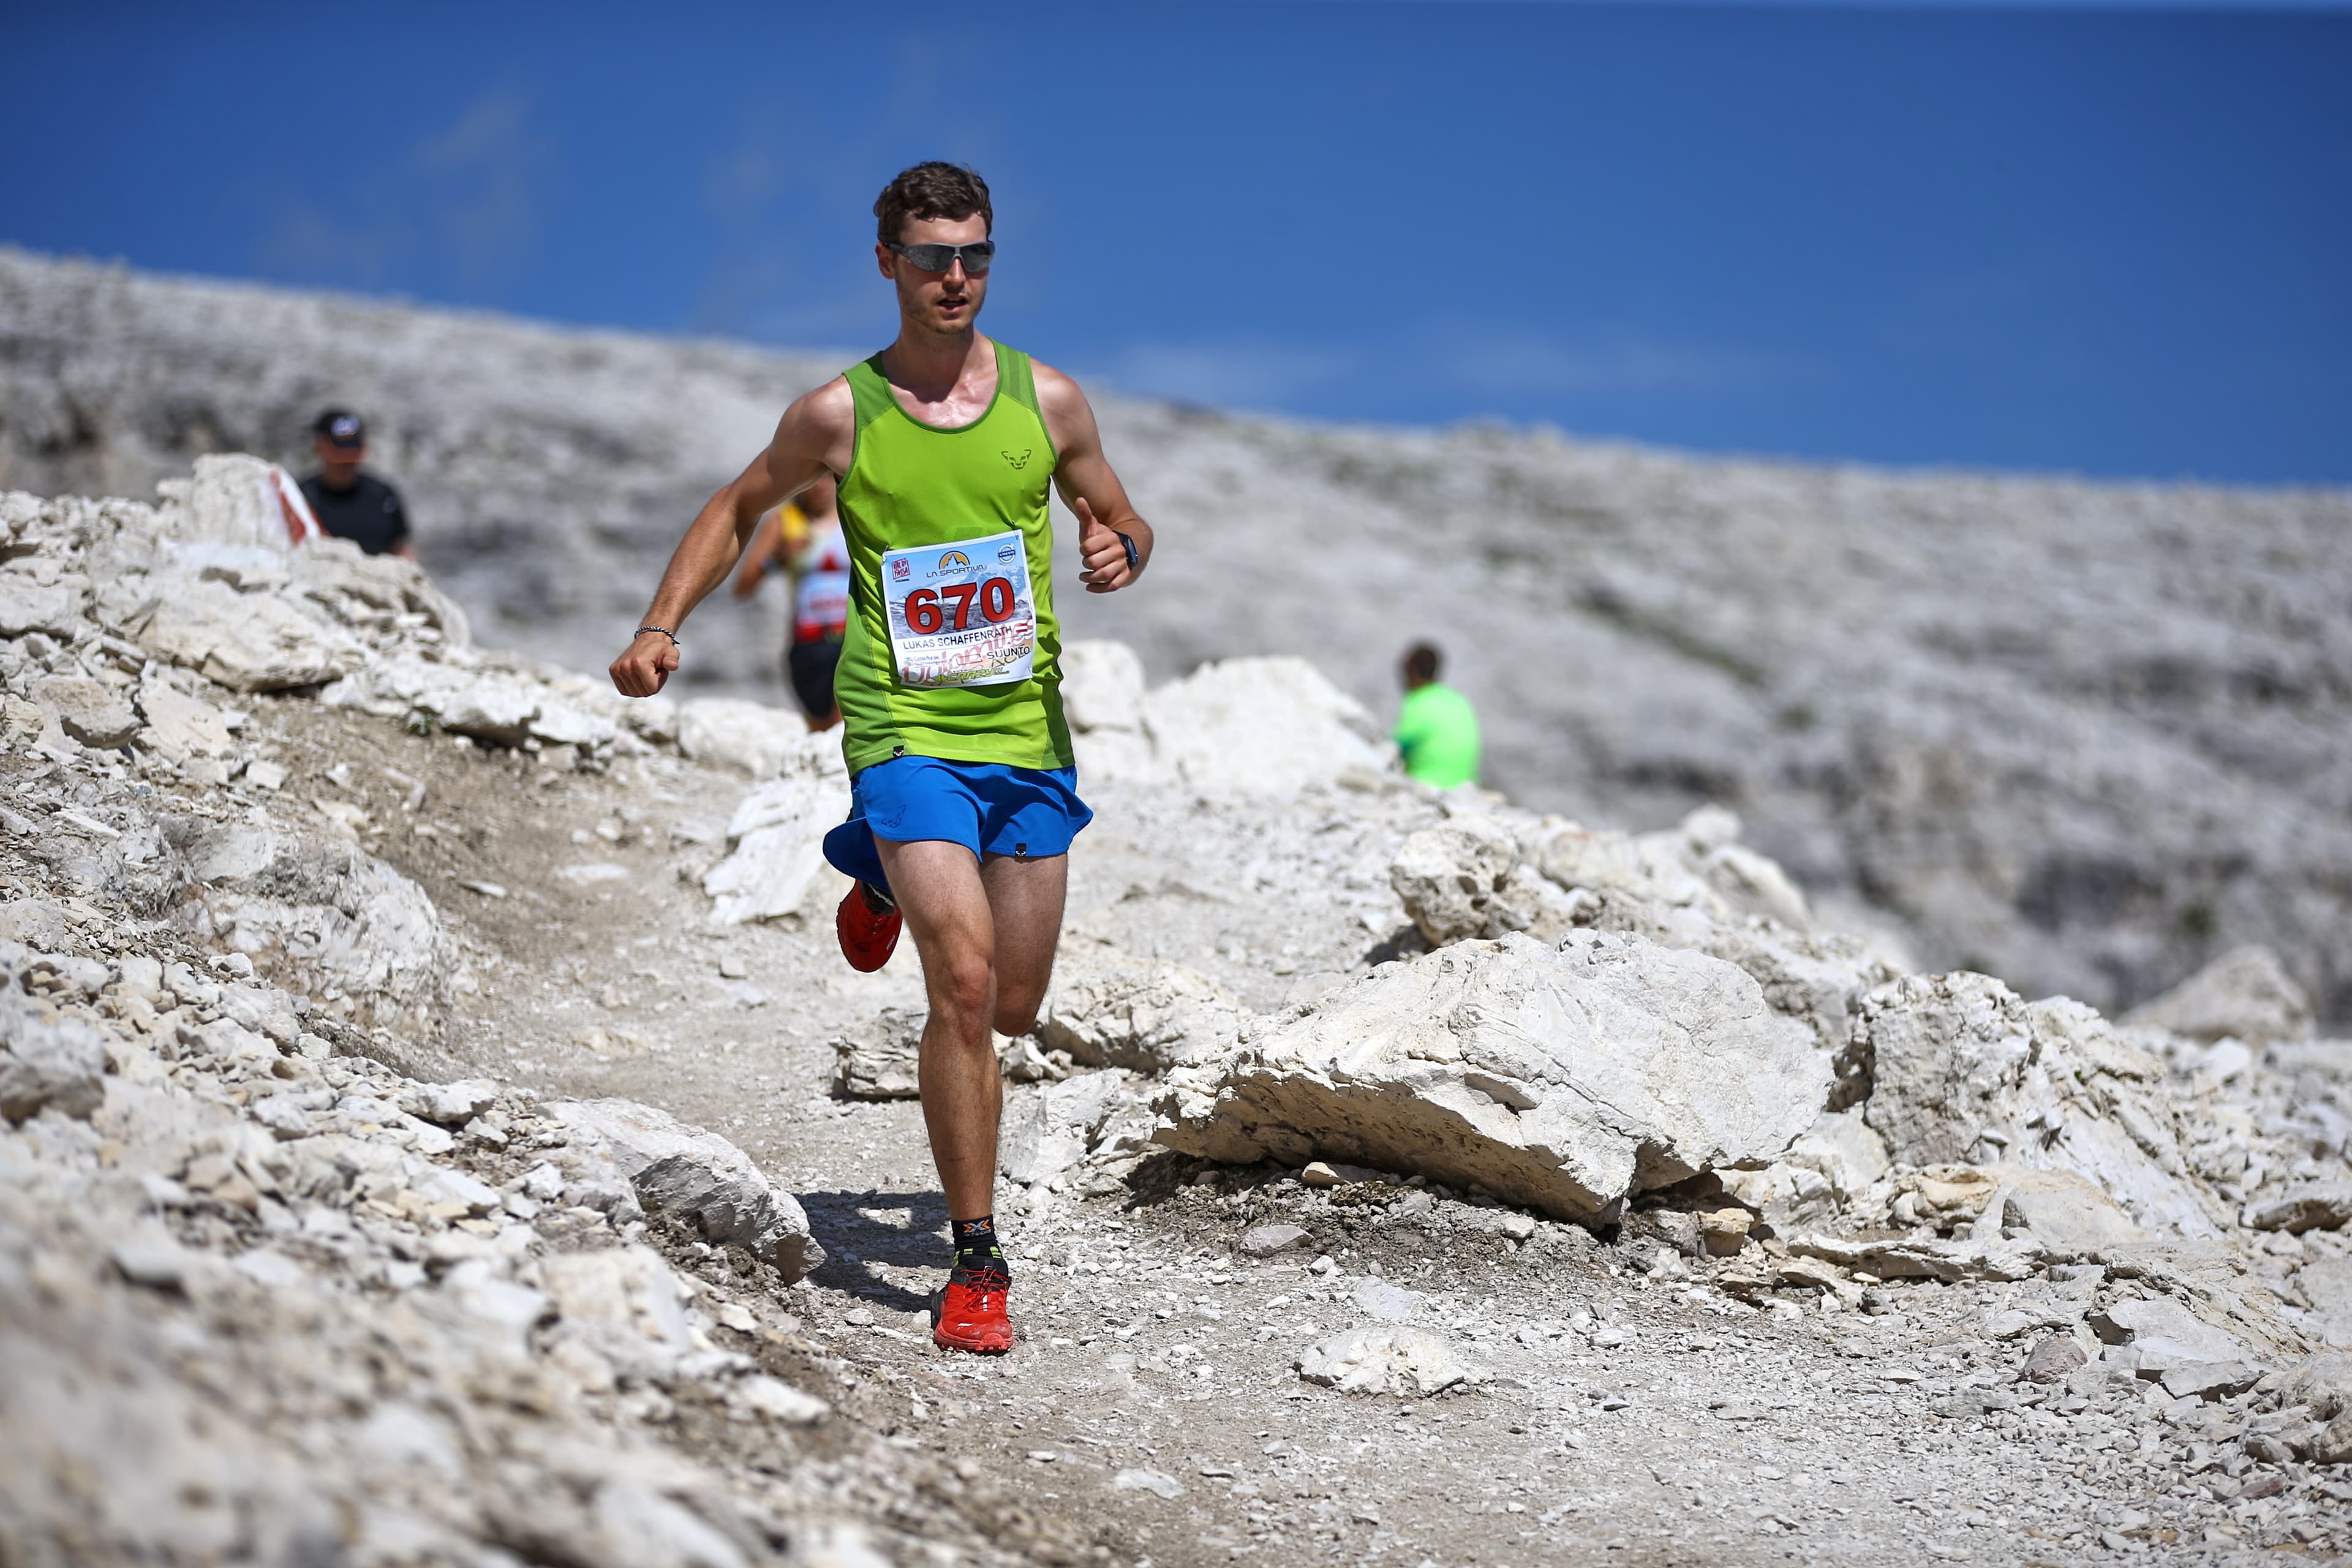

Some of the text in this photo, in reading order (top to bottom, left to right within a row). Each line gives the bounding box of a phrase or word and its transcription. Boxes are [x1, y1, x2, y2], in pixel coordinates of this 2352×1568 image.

[940, 565, 984, 576] SPORTIVA
[905, 577, 1015, 634] 670
[903, 626, 1012, 649] LUKAS SCHAFFENRATH
[987, 646, 1030, 659] SUUNTO
[948, 668, 994, 681] CRAZY
